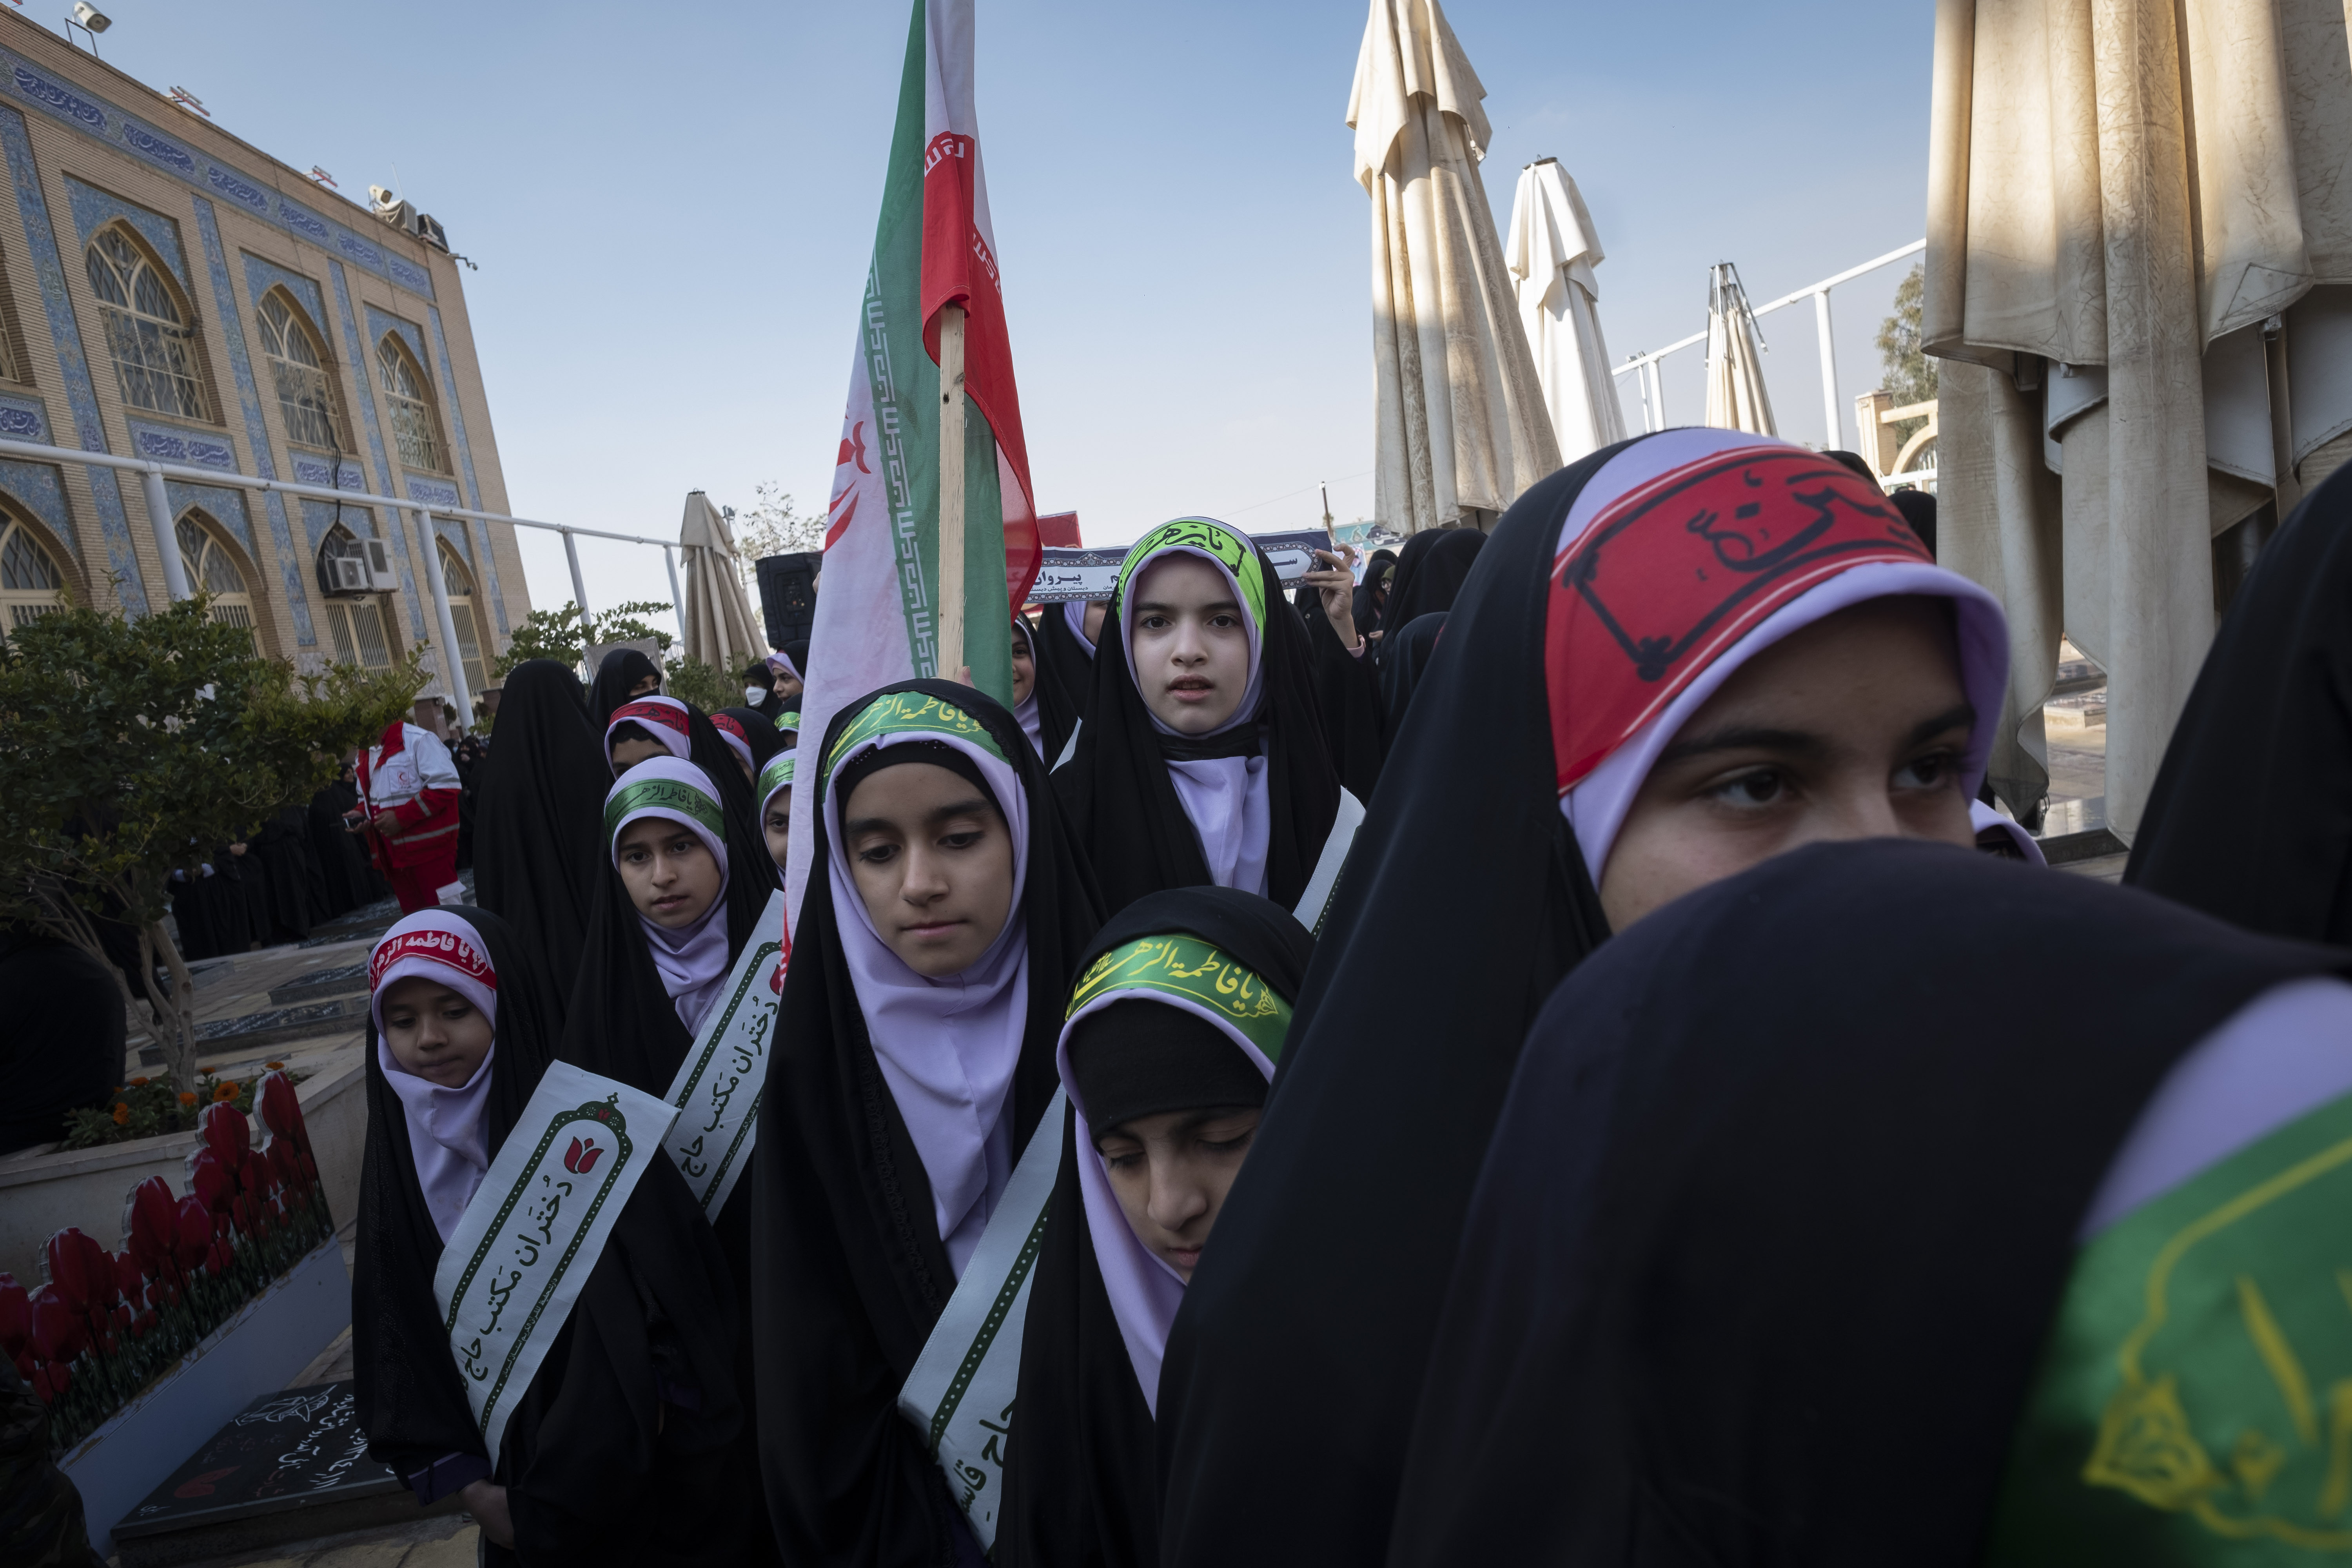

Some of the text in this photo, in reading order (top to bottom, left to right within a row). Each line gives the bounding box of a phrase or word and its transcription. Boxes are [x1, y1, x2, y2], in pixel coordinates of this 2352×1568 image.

[686, 792, 692, 811] یا
[405, 931, 455, 951] فاطمه
[458, 939, 470, 963] یا
[1233, 972, 1254, 1011] یا
[679, 1135, 708, 1178] حاج
[460, 1337, 489, 1381] حاج
